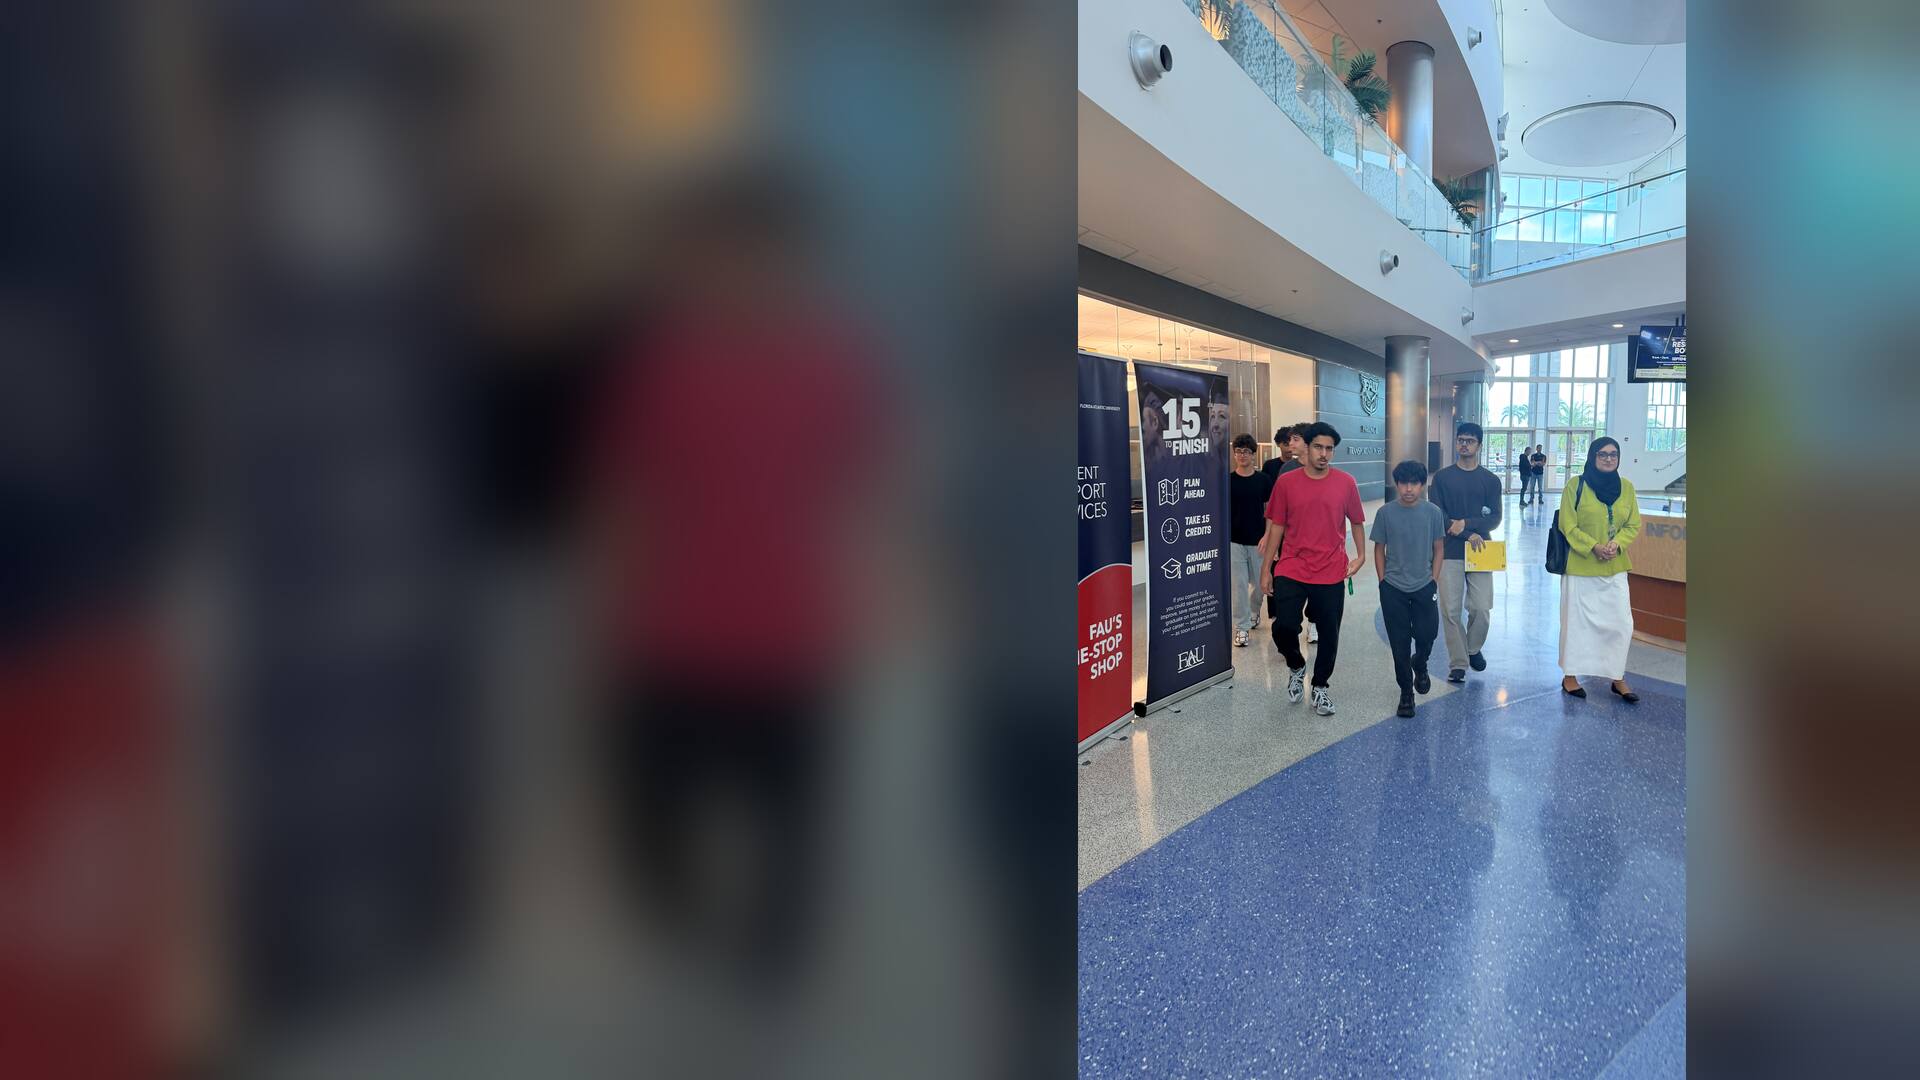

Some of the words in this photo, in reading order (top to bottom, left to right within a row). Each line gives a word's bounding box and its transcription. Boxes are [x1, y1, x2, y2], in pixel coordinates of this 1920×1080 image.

[1161, 397, 1201, 440] 15
[1165, 440, 1172, 448] TO
[1172, 437, 1209, 456] FINISH
[1077, 466, 1099, 480] ENT
[1183, 478, 1201, 487] PLAN
[1184, 489, 1205, 499] AHEAD
[1185, 516, 1201, 526] TAKE
[1201, 514, 1210, 523] 15
[1185, 525, 1212, 538] CREDITS
[1646, 522, 1686, 540] INFO
[1186, 549, 1218, 563] GRADUATE
[1186, 565, 1196, 575] ON
[1196, 561, 1212, 573] TIME
[1089, 614, 1122, 640] FAU'S
[1178, 645, 1206, 671] FAU
[1090, 652, 1123, 680] SHOP
